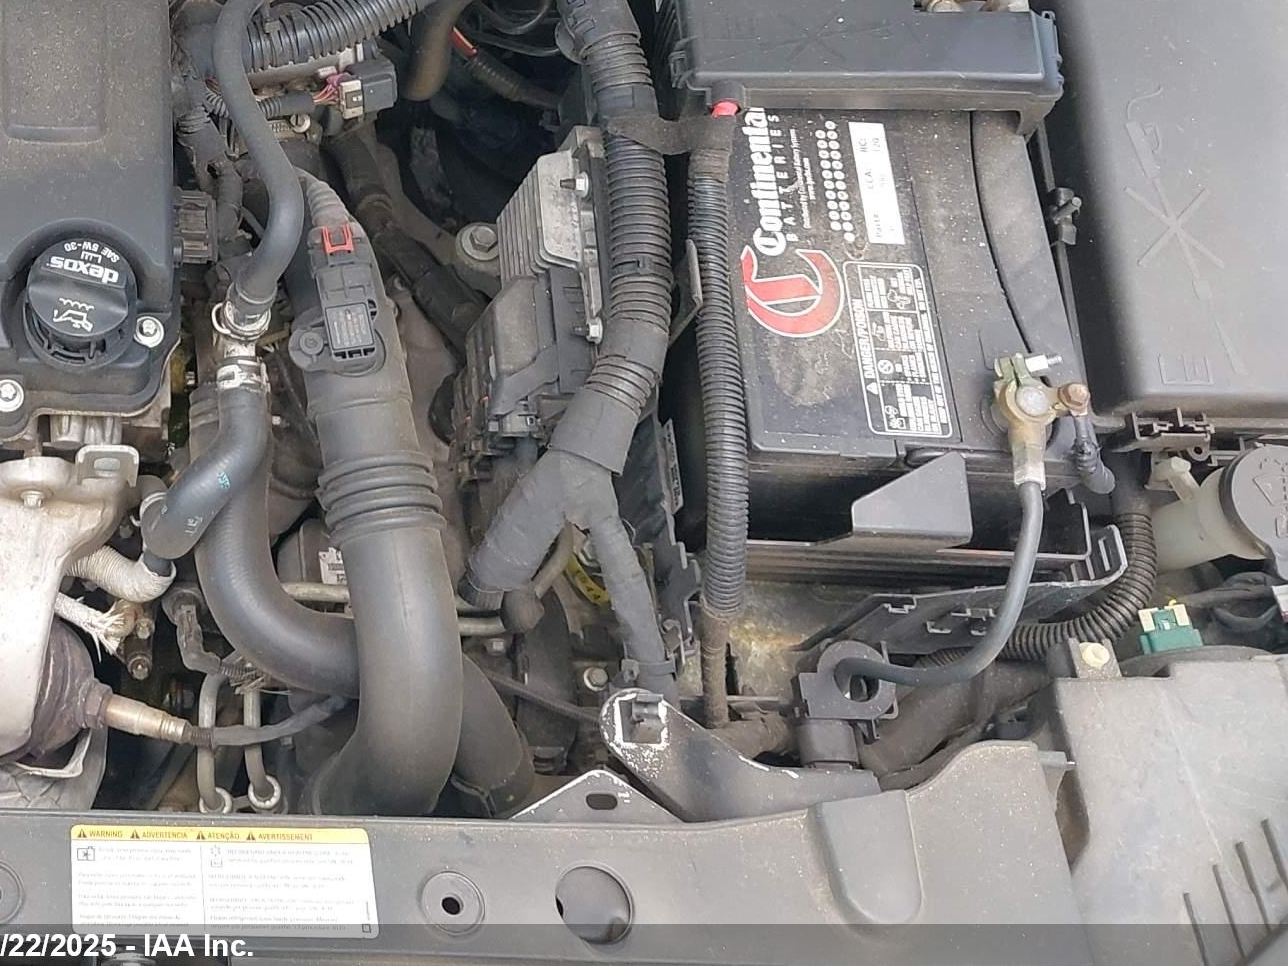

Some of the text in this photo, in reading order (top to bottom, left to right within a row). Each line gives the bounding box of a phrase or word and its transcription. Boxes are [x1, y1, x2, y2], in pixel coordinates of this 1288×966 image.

[768, 114, 799, 242] BATTERIES
[64, 241, 99, 252] 5W-30
[100, 246, 120, 263] SAE
[49, 255, 119, 284] dexos
[852, 298, 875, 379] DANGER/POISON
[89, 830, 123, 838] WARNING
[142, 831, 188, 839] ADVERTENCIA
[258, 833, 313, 841] AVERTISSEMENT
